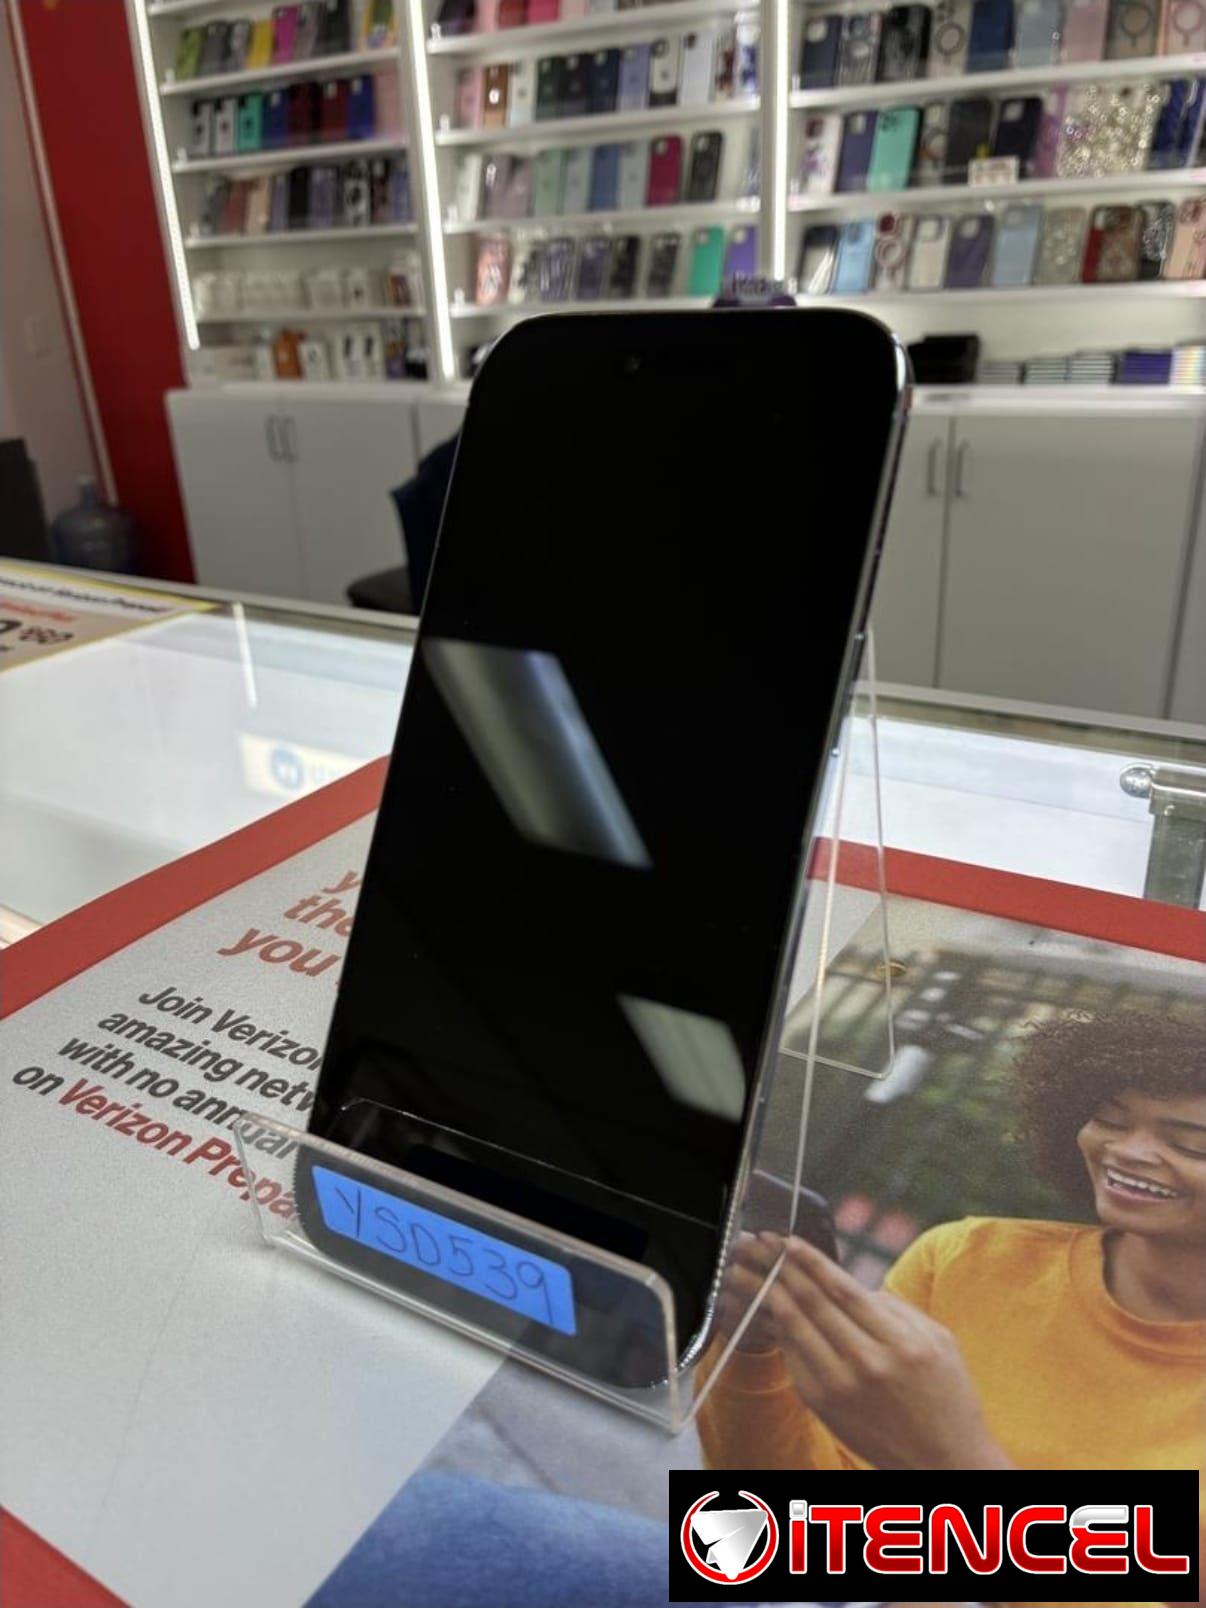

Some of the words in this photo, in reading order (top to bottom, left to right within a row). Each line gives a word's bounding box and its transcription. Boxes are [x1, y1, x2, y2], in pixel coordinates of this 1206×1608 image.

[216, 927, 341, 977] you
[138, 986, 213, 1025] Join
[57, 1037, 135, 1080] with
[124, 1067, 180, 1098] no
[97, 1012, 244, 1083] amazing
[12, 1066, 65, 1096] on
[57, 1077, 193, 1156] Verizon
[334, 1186, 554, 1325] YSD539
